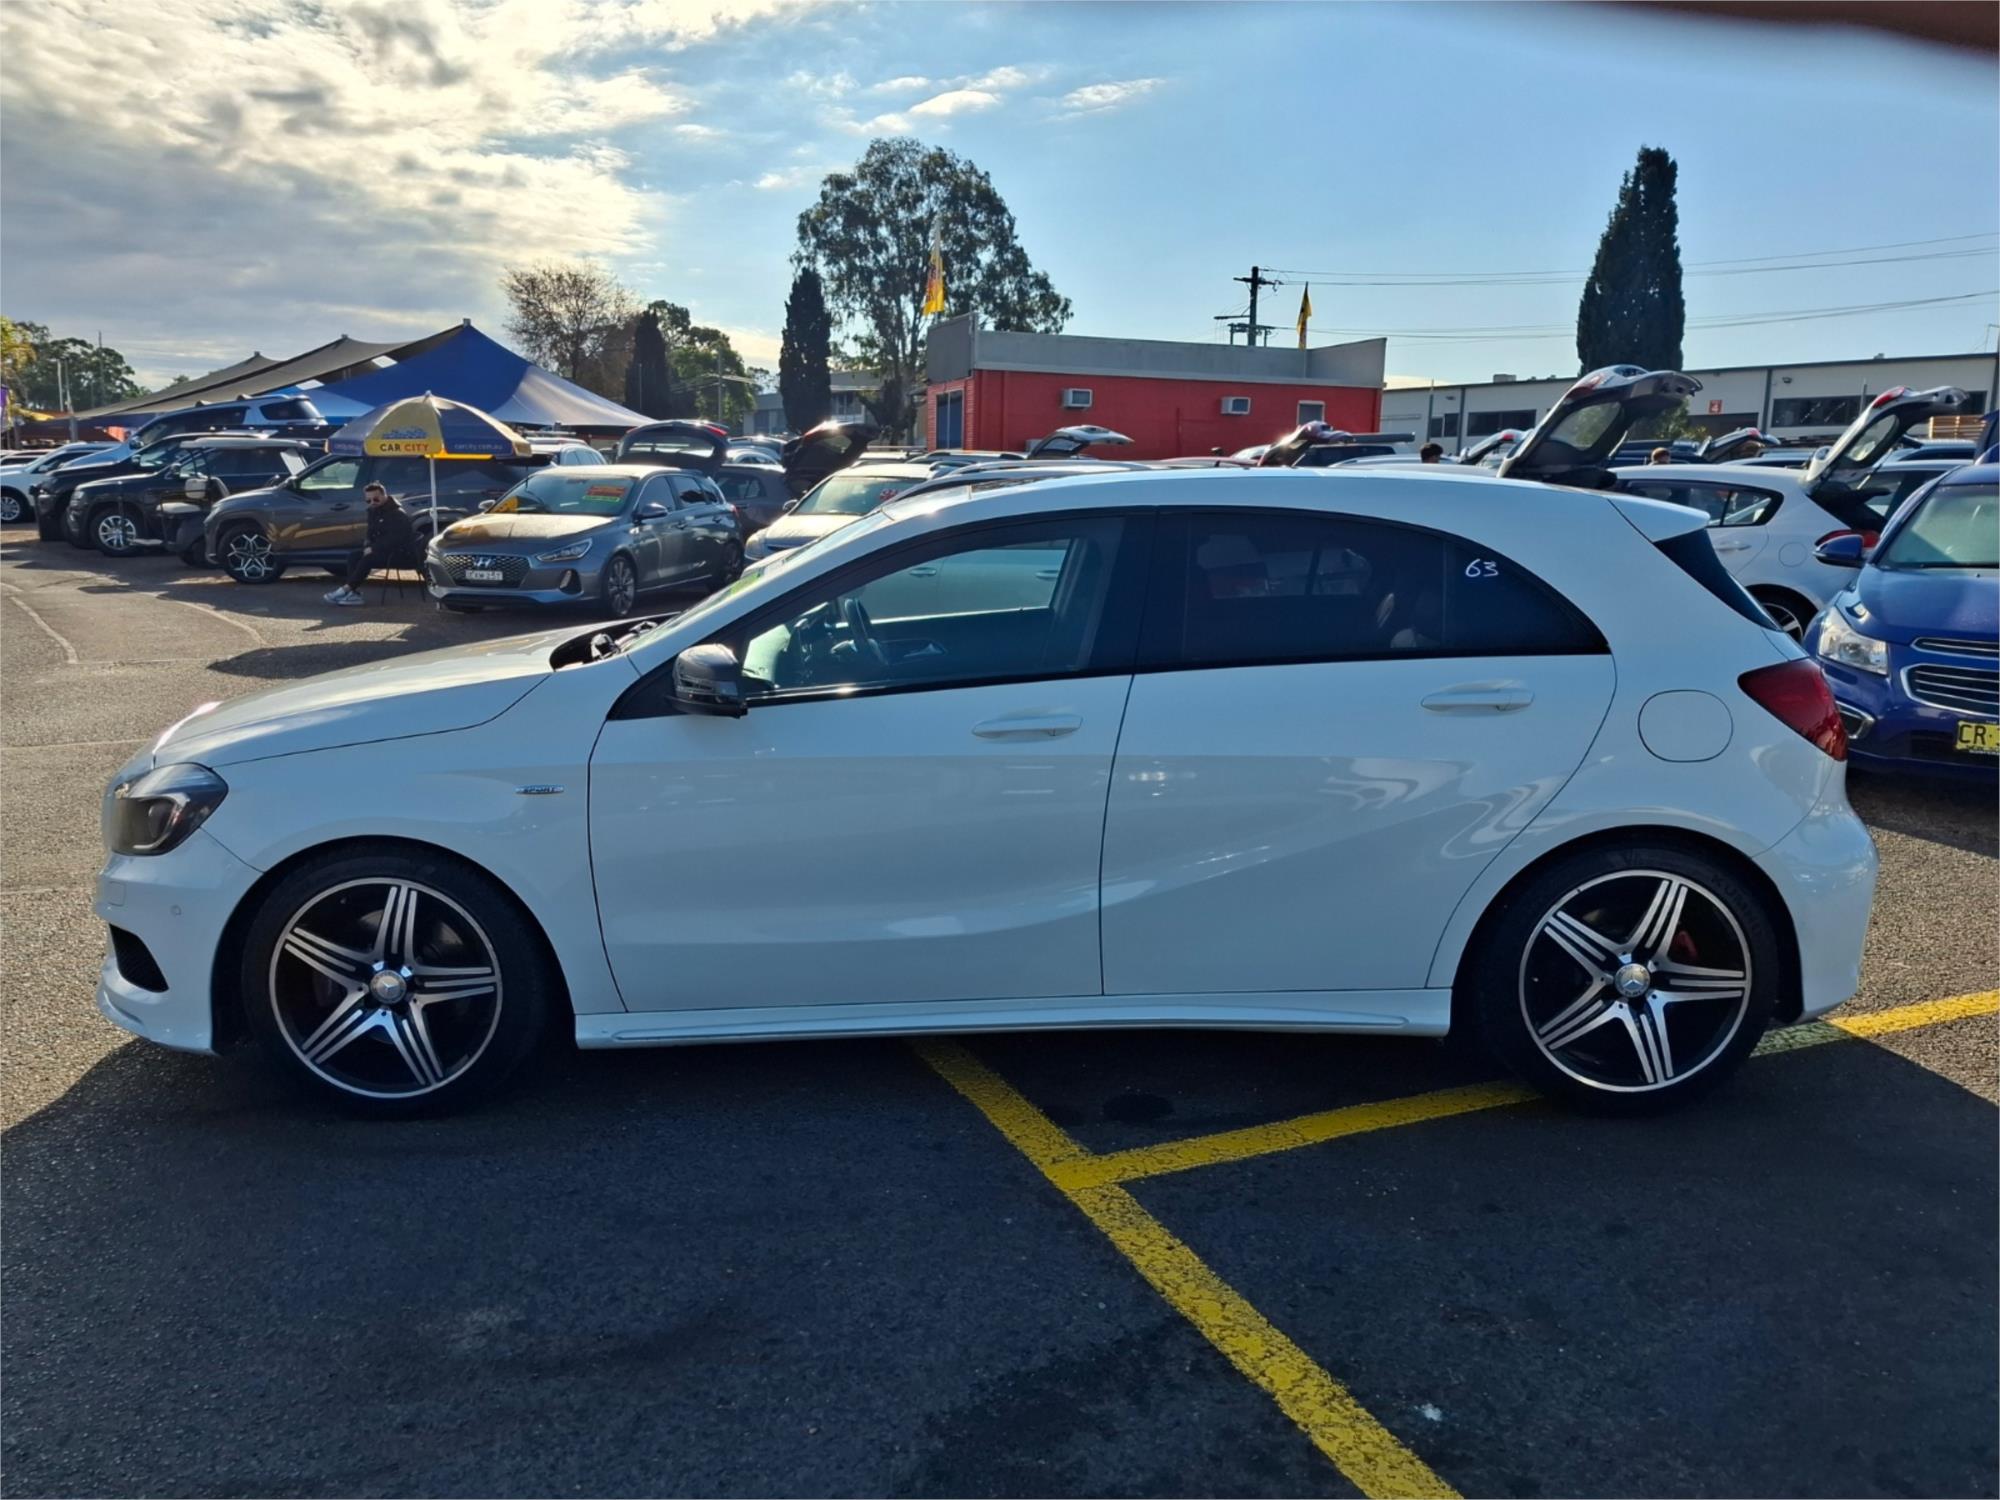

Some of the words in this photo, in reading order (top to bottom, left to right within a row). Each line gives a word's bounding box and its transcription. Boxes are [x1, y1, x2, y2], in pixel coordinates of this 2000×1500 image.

[379, 443, 401, 452] CAR
[404, 443, 429, 452] CITY
[1466, 558, 1499, 578] 63
